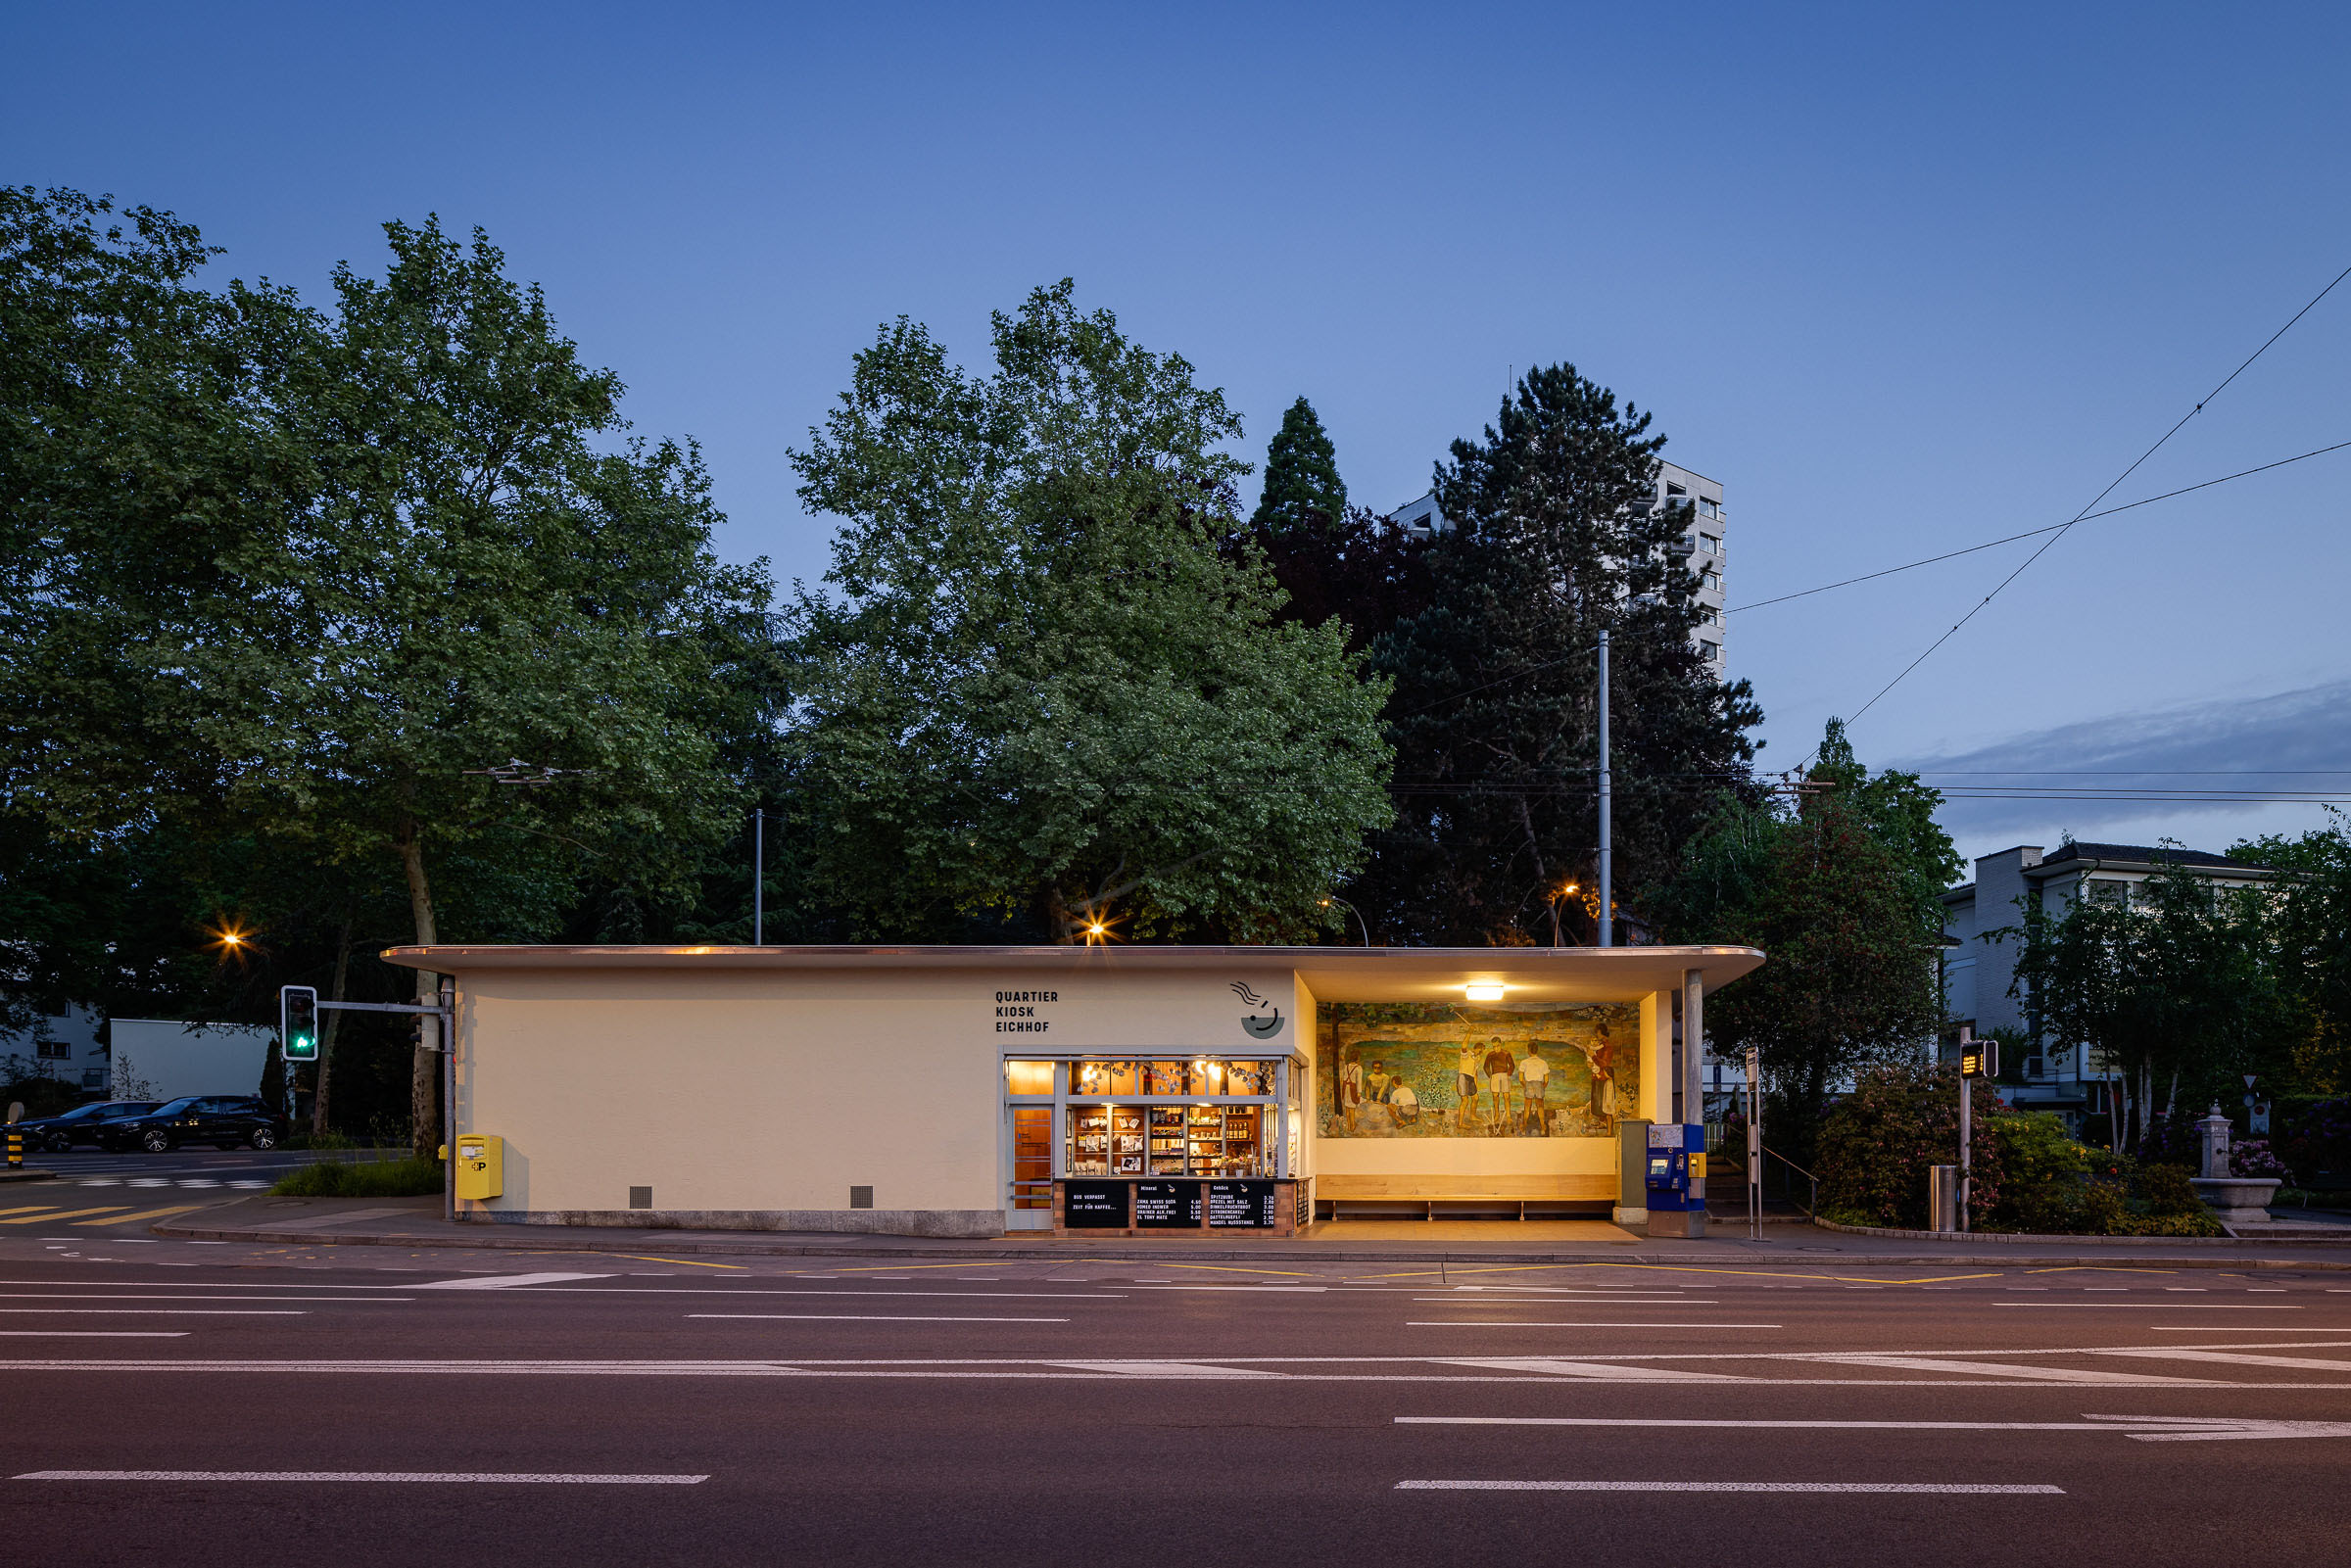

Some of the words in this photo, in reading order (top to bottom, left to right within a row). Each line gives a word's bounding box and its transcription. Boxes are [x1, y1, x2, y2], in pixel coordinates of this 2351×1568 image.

[995, 991, 1058, 1003] QUARTIER
[995, 1006, 1034, 1017] KIOSK
[995, 1022, 1049, 1032] EICHHOF
[478, 1163, 486, 1171] P
